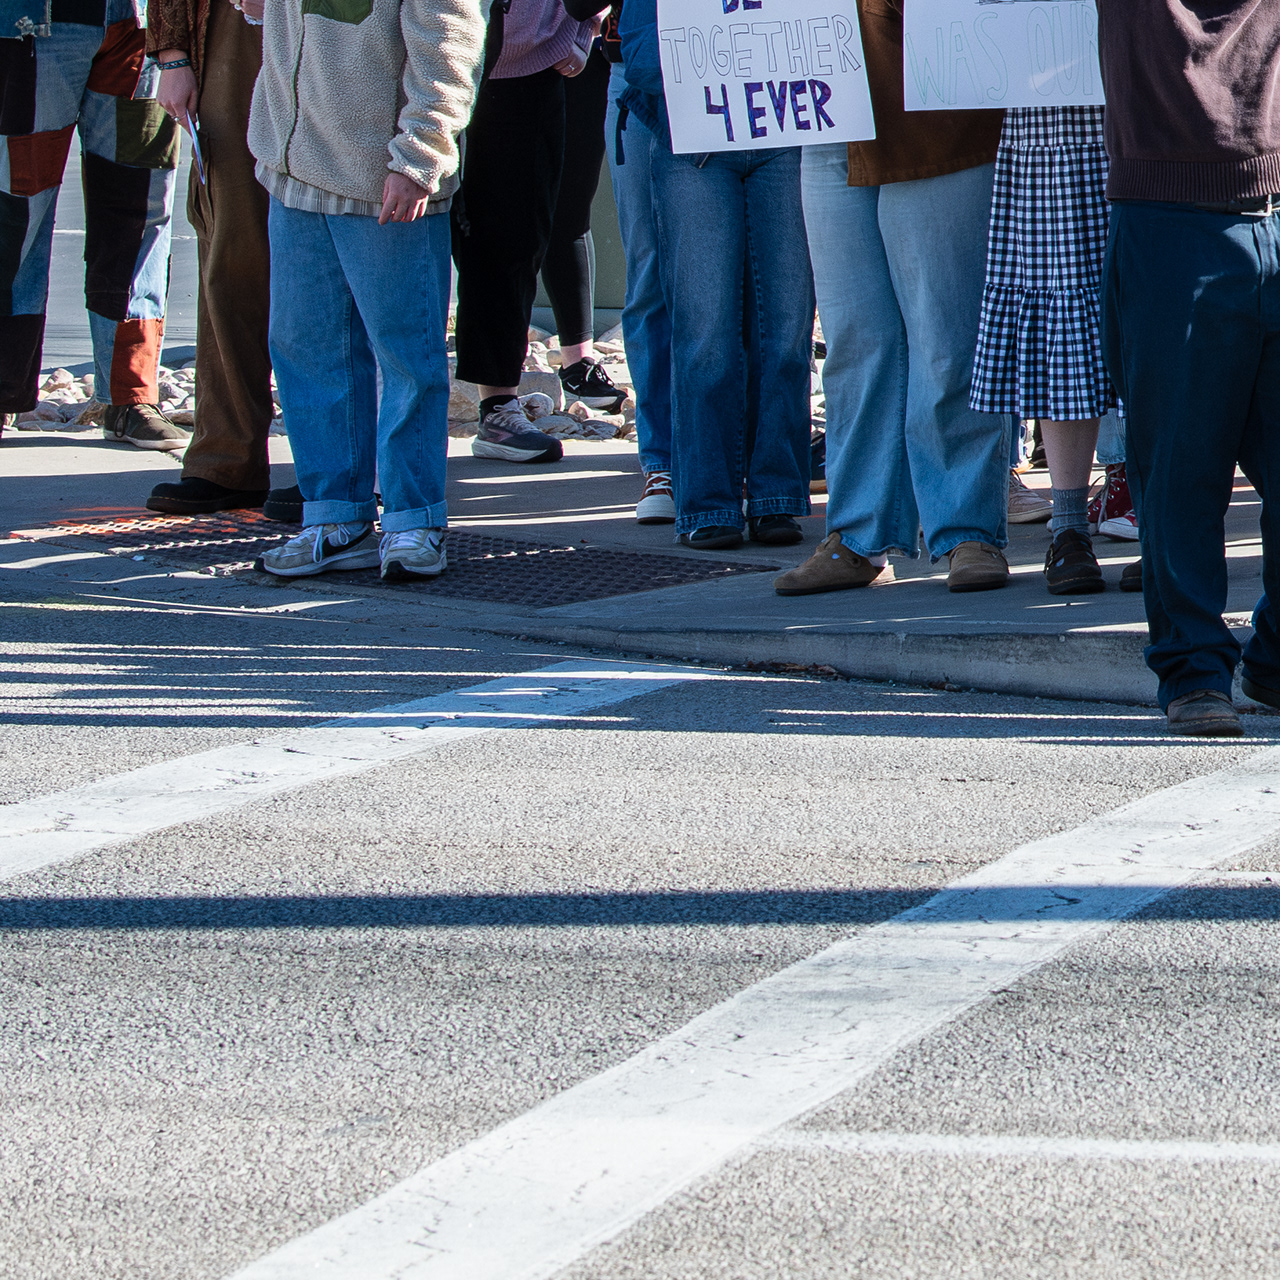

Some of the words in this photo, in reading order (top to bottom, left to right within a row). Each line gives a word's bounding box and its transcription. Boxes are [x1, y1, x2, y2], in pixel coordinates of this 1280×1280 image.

[660, 14, 861, 83] TOGETHER
[904, 11, 1008, 107] WAS
[703, 83, 735, 143] 4
[745, 77, 836, 139] EVER
